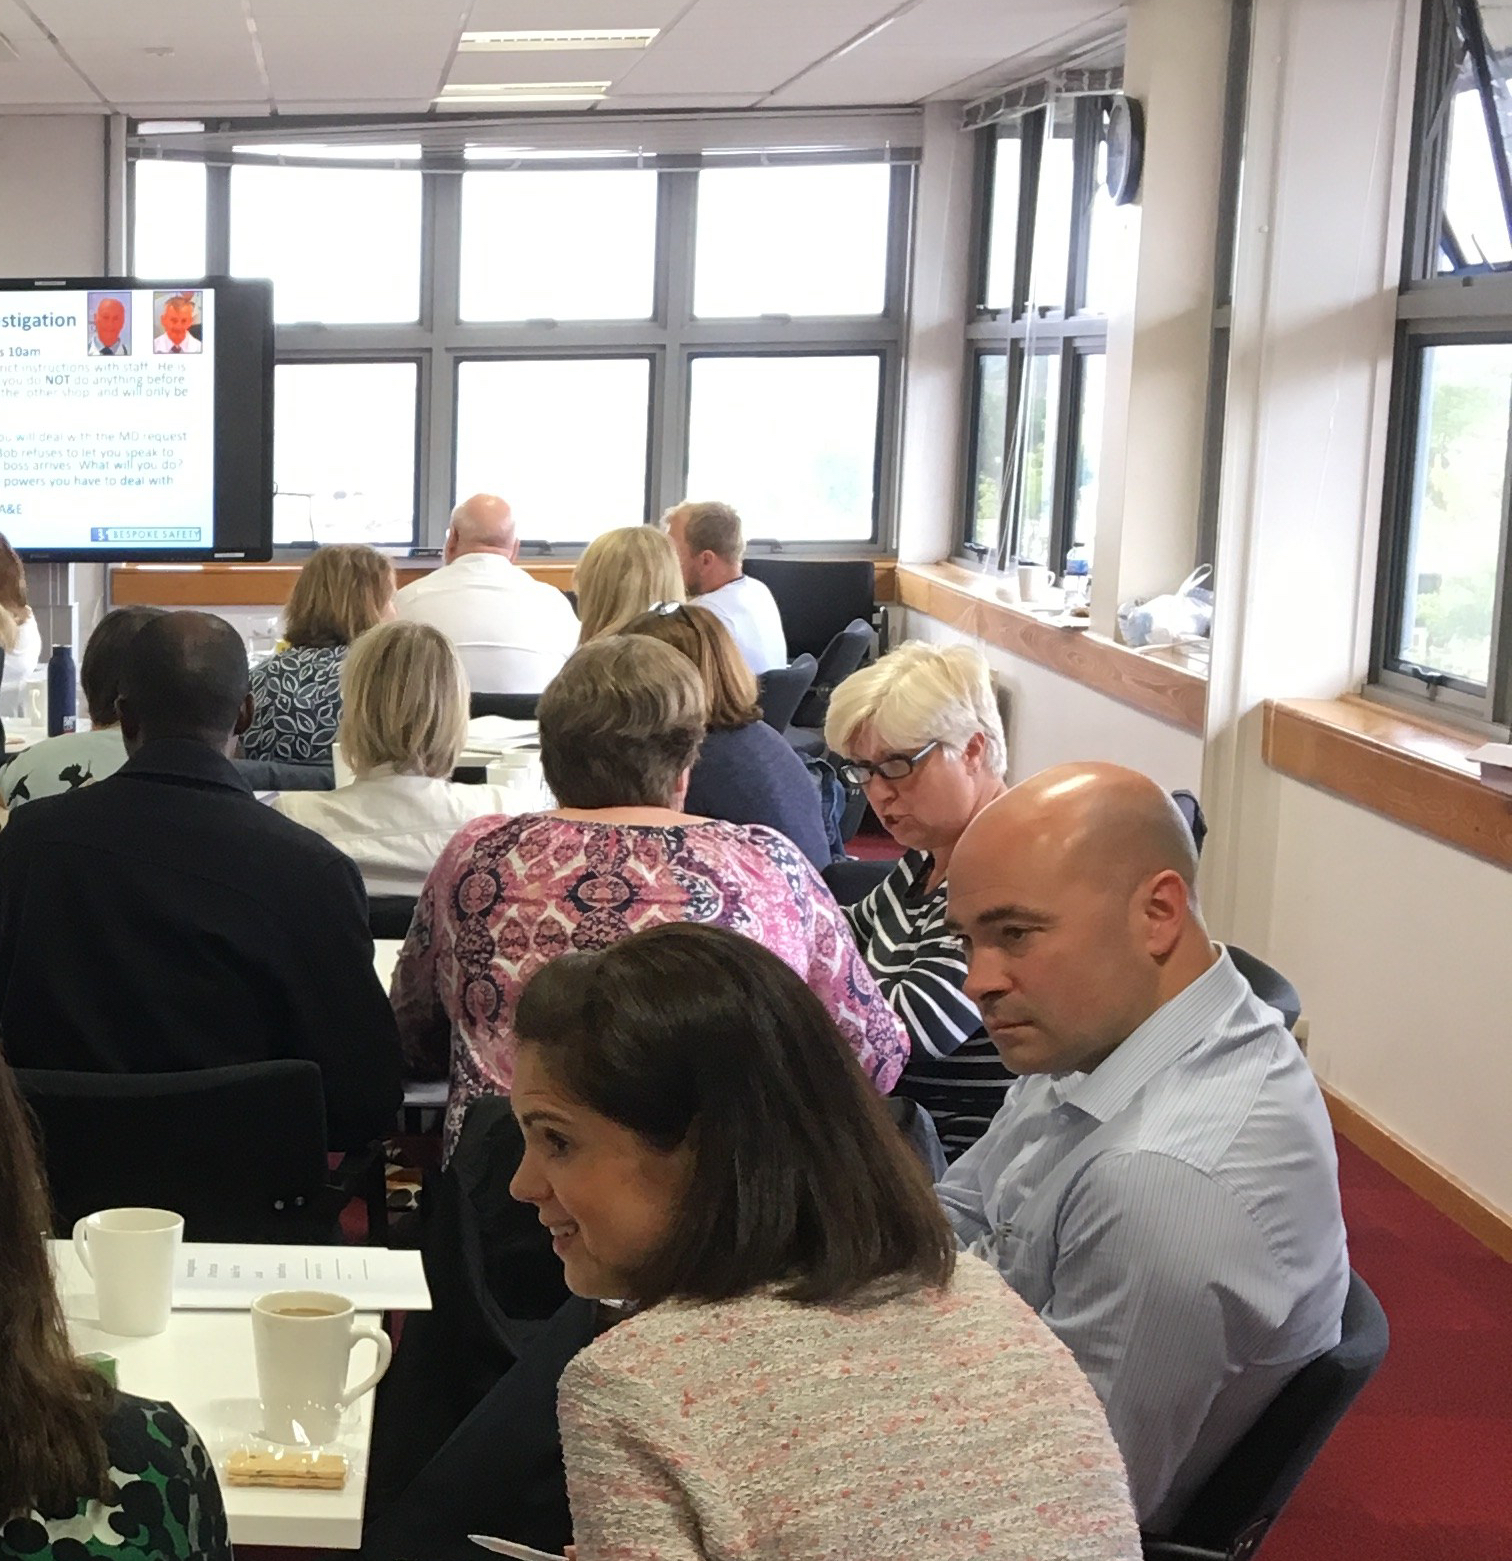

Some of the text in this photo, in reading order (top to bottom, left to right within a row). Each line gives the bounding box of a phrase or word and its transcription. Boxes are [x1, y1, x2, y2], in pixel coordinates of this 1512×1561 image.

[8, 347, 41, 357] 10am
[21, 362, 90, 373] instructions
[94, 362, 119, 372] with
[2, 377, 23, 387] you
[26, 375, 41, 386] do
[45, 375, 70, 385] NOT
[74, 375, 89, 385] do
[93, 374, 143, 388] anything
[146, 373, 185, 385] before
[1, 388, 19, 398] the
[26, 387, 58, 398] other
[97, 387, 118, 397] and
[122, 386, 142, 397] will
[145, 387, 170, 398] only
[174, 387, 188, 397] be
[16, 432, 35, 442] will
[39, 432, 63, 442] deal
[67, 432, 92, 442] wth
[96, 432, 115, 442] the
[119, 431, 140, 441] MD
[21, 448, 63, 459] refuses
[66, 448, 78, 457] to
[82, 448, 96, 457] let
[100, 449, 121, 459] you
[126, 448, 158, 460] speak
[162, 448, 174, 457] to
[3, 461, 29, 471] boss
[79, 460, 109, 471] What
[114, 459, 133, 470] will
[137, 461, 157, 472] you
[162, 459, 183, 470] do?
[4, 477, 45, 489] powers
[49, 477, 70, 488] you
[74, 475, 100, 486] have
[104, 476, 116, 486] to
[120, 475, 144, 486] deal
[149, 475, 174, 486] with
[113, 530, 201, 539] BESPOKE SAFETY
